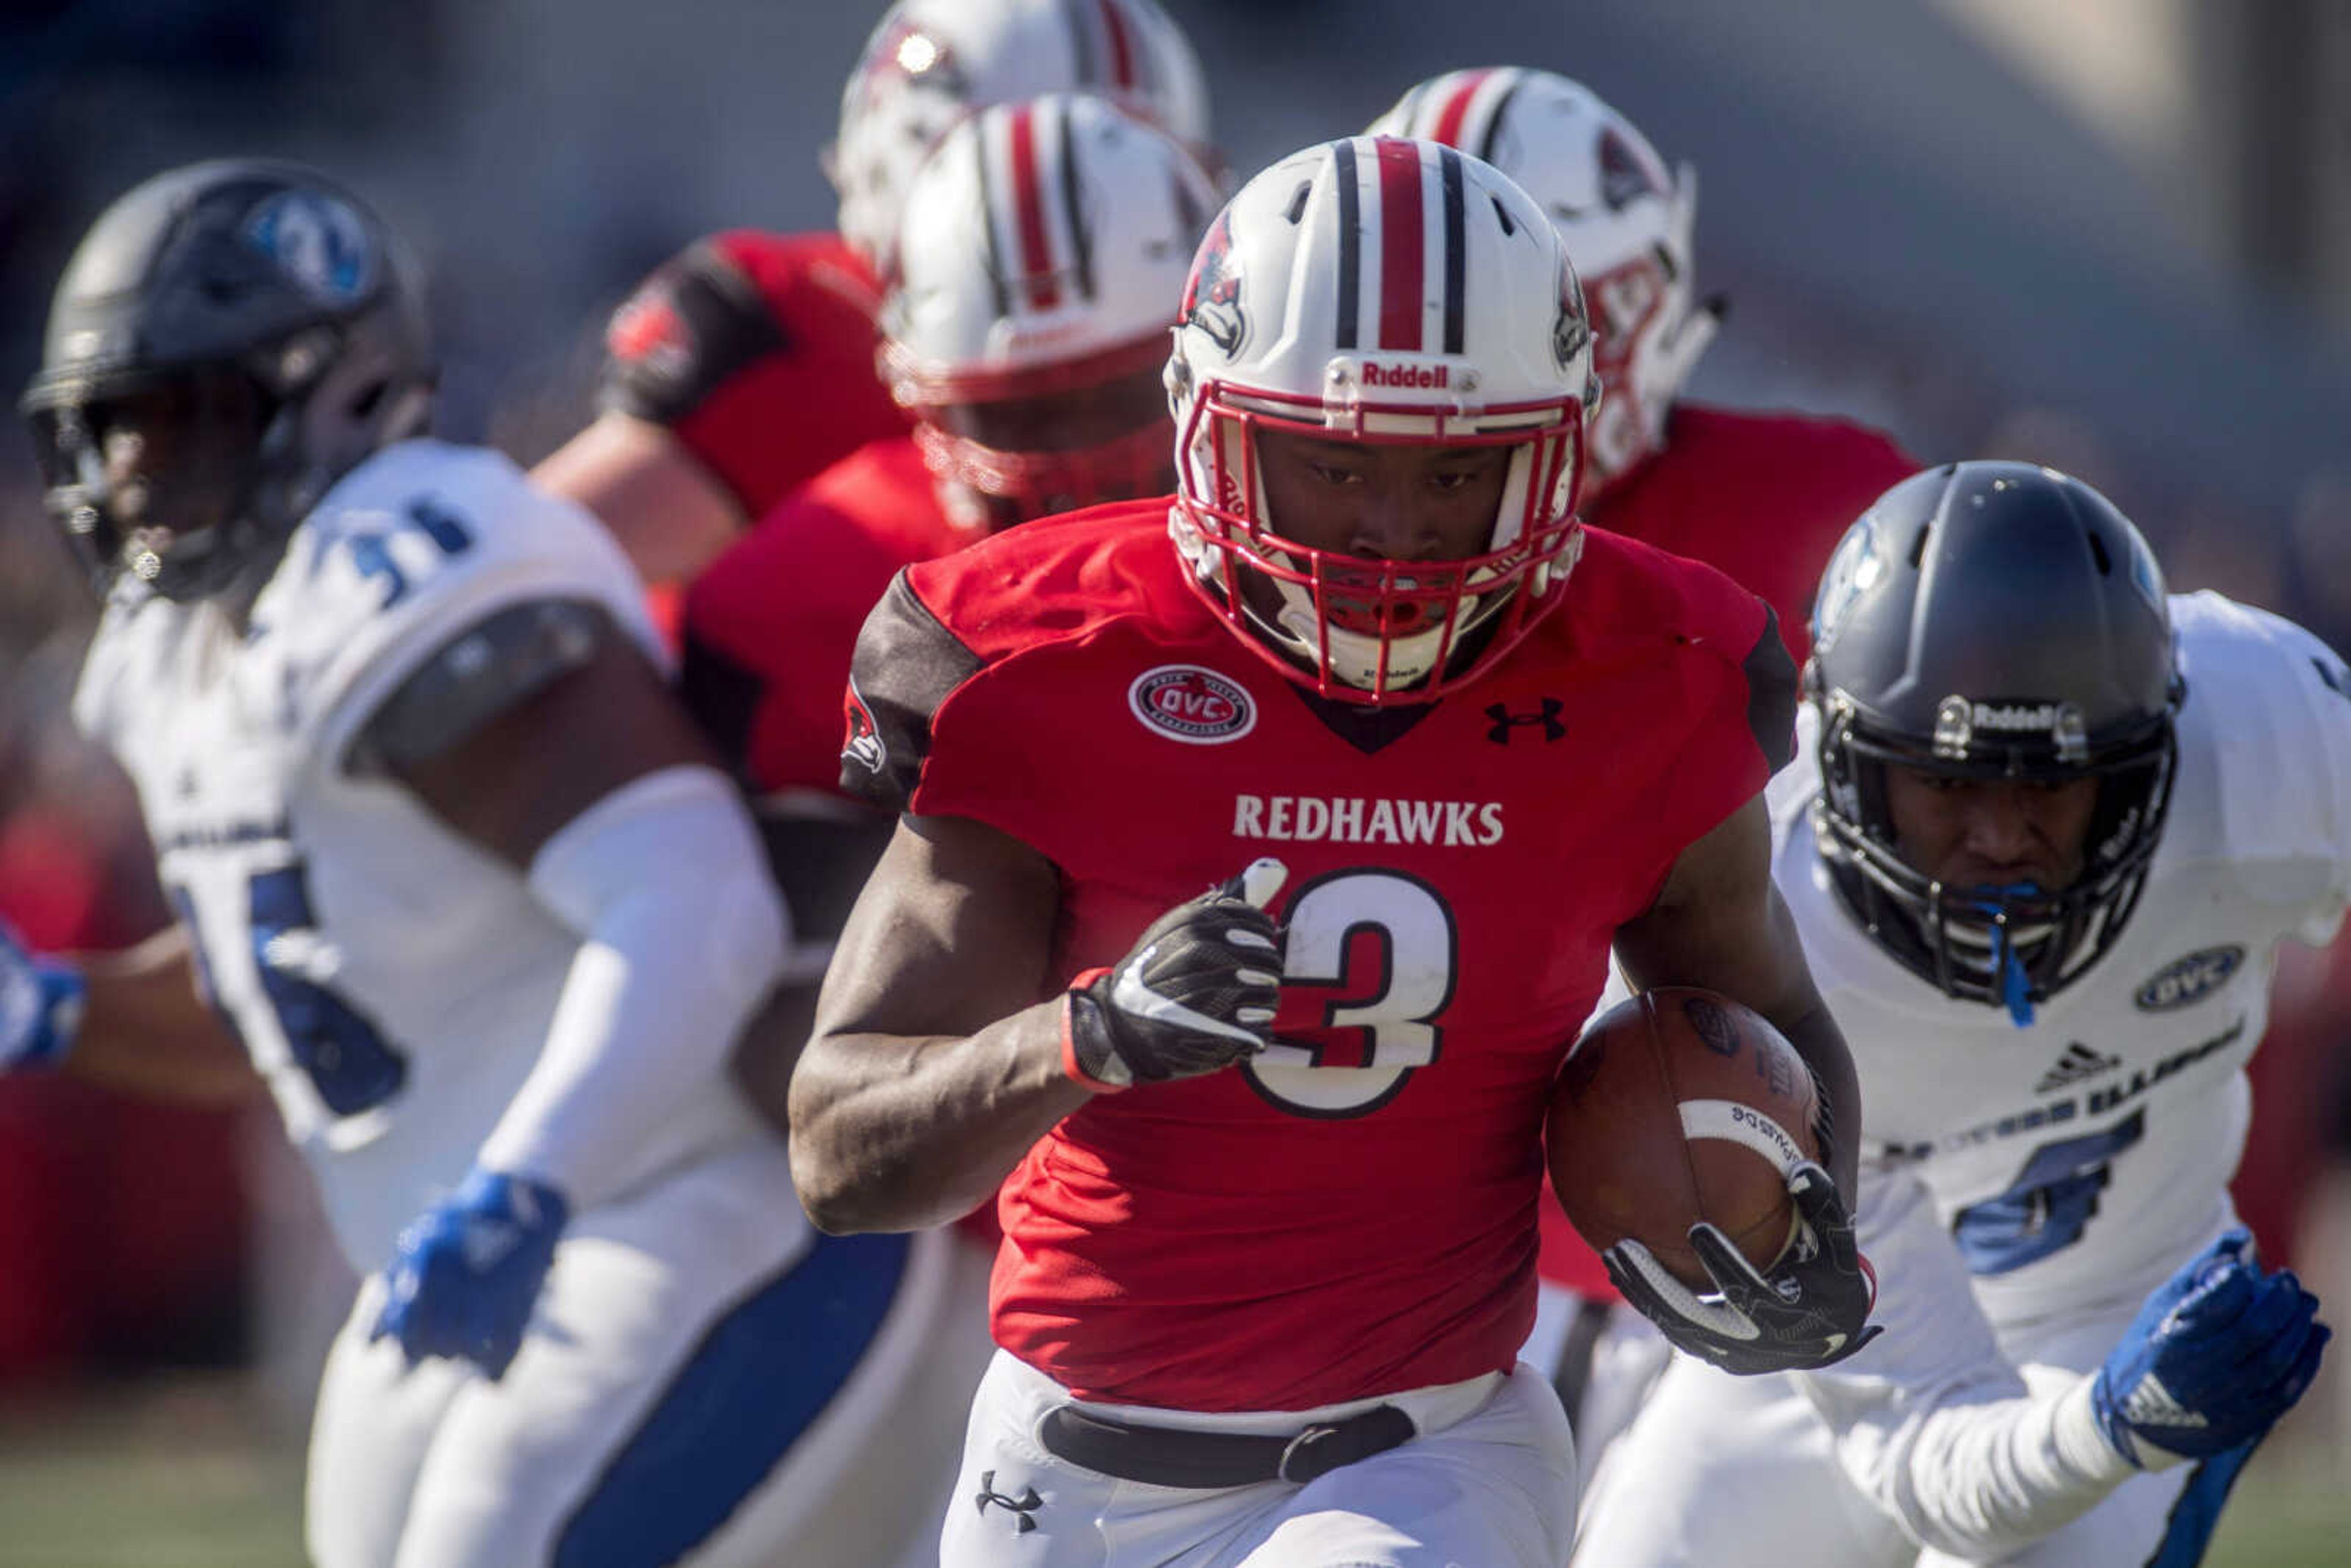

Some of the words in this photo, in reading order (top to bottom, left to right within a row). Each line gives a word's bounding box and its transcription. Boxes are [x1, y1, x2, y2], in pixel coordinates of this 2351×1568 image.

[1362, 361, 1449, 389] Riddell
[1161, 688, 1223, 719] OVC
[1973, 702, 2054, 730] Riddell
[1232, 794, 1504, 846] REDHAWKS
[1238, 866, 1458, 1119] 3
[2154, 956, 2229, 1005] OVC
